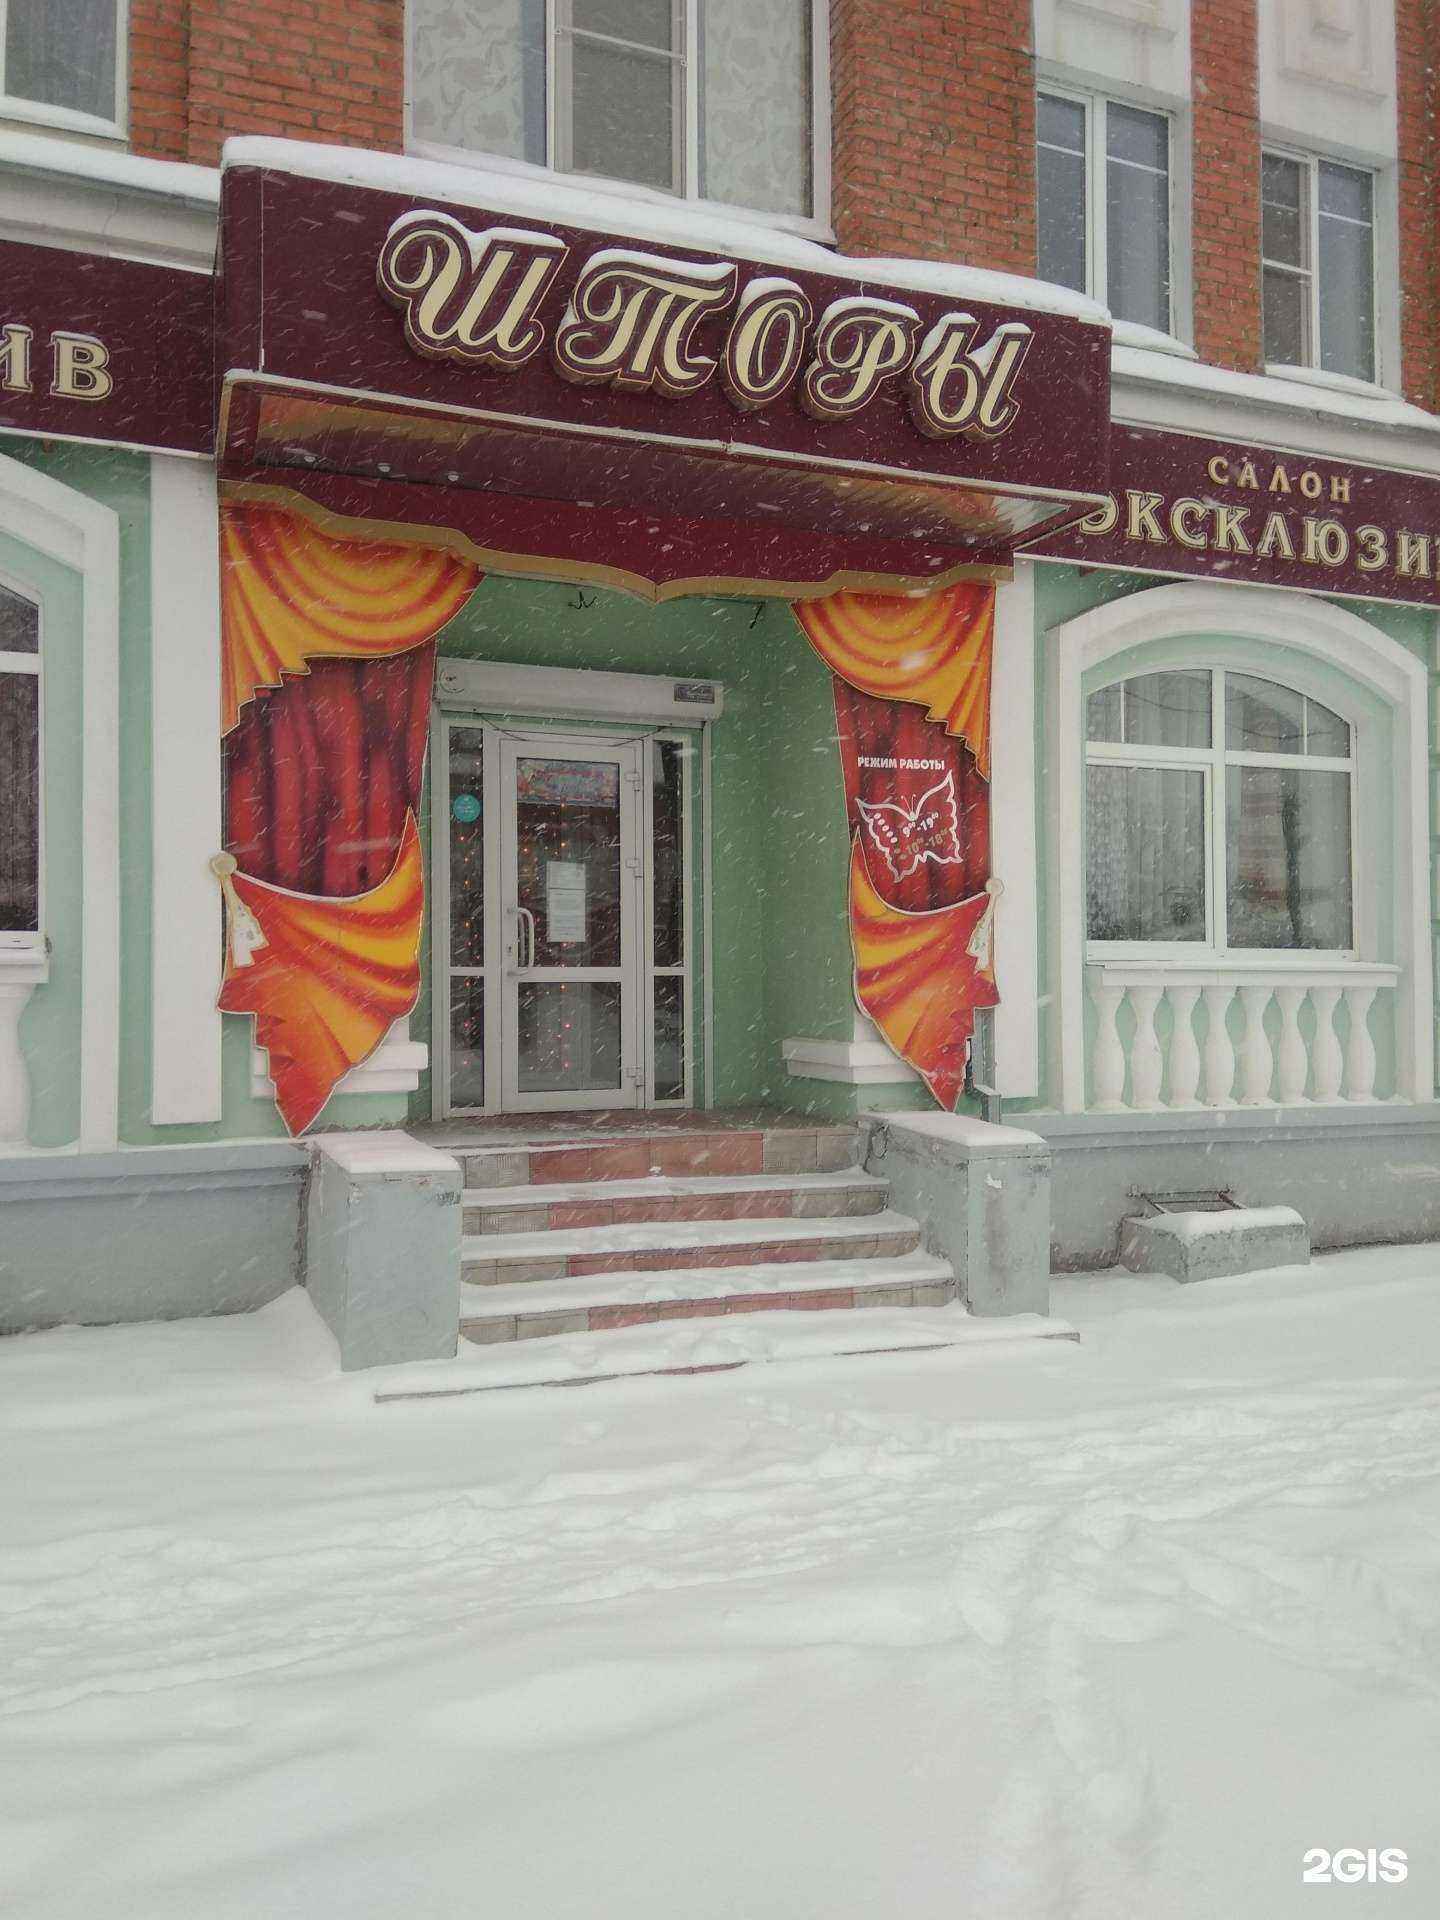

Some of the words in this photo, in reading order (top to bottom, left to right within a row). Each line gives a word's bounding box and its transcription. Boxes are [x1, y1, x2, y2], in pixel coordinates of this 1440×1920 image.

[379, 220, 1032, 437] ШТОРЫ
[1207, 456, 1352, 503] САЛОН
[1079, 489, 1440, 578] ЭКСКЛЮЗИ
[857, 756, 897, 769] РЕЖИМ
[900, 758, 945, 770] РАБОТЫ
